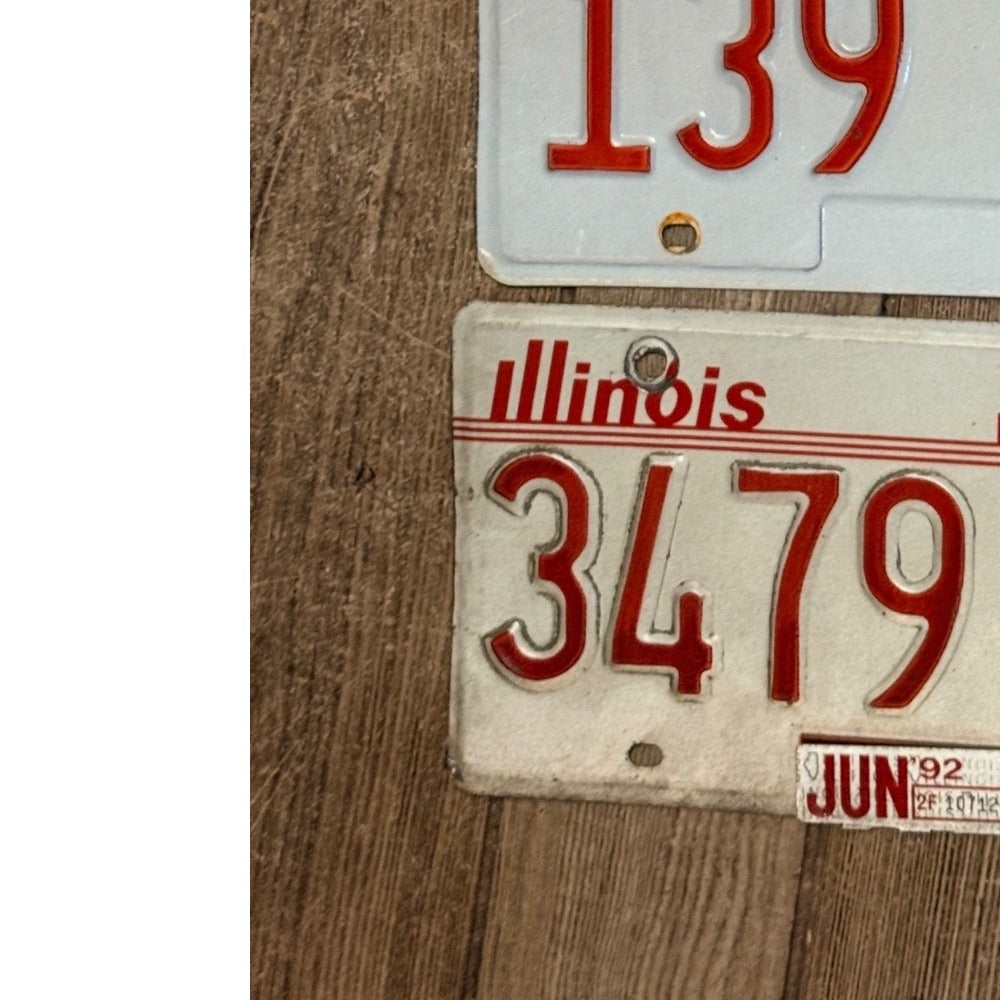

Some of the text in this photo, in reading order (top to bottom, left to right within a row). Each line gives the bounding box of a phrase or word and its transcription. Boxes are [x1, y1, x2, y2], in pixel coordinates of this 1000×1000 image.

[489, 339, 767, 431] Illinois
[489, 453, 965, 709] 3479
[806, 753, 909, 819] JUN
[911, 757, 963, 780] '92
